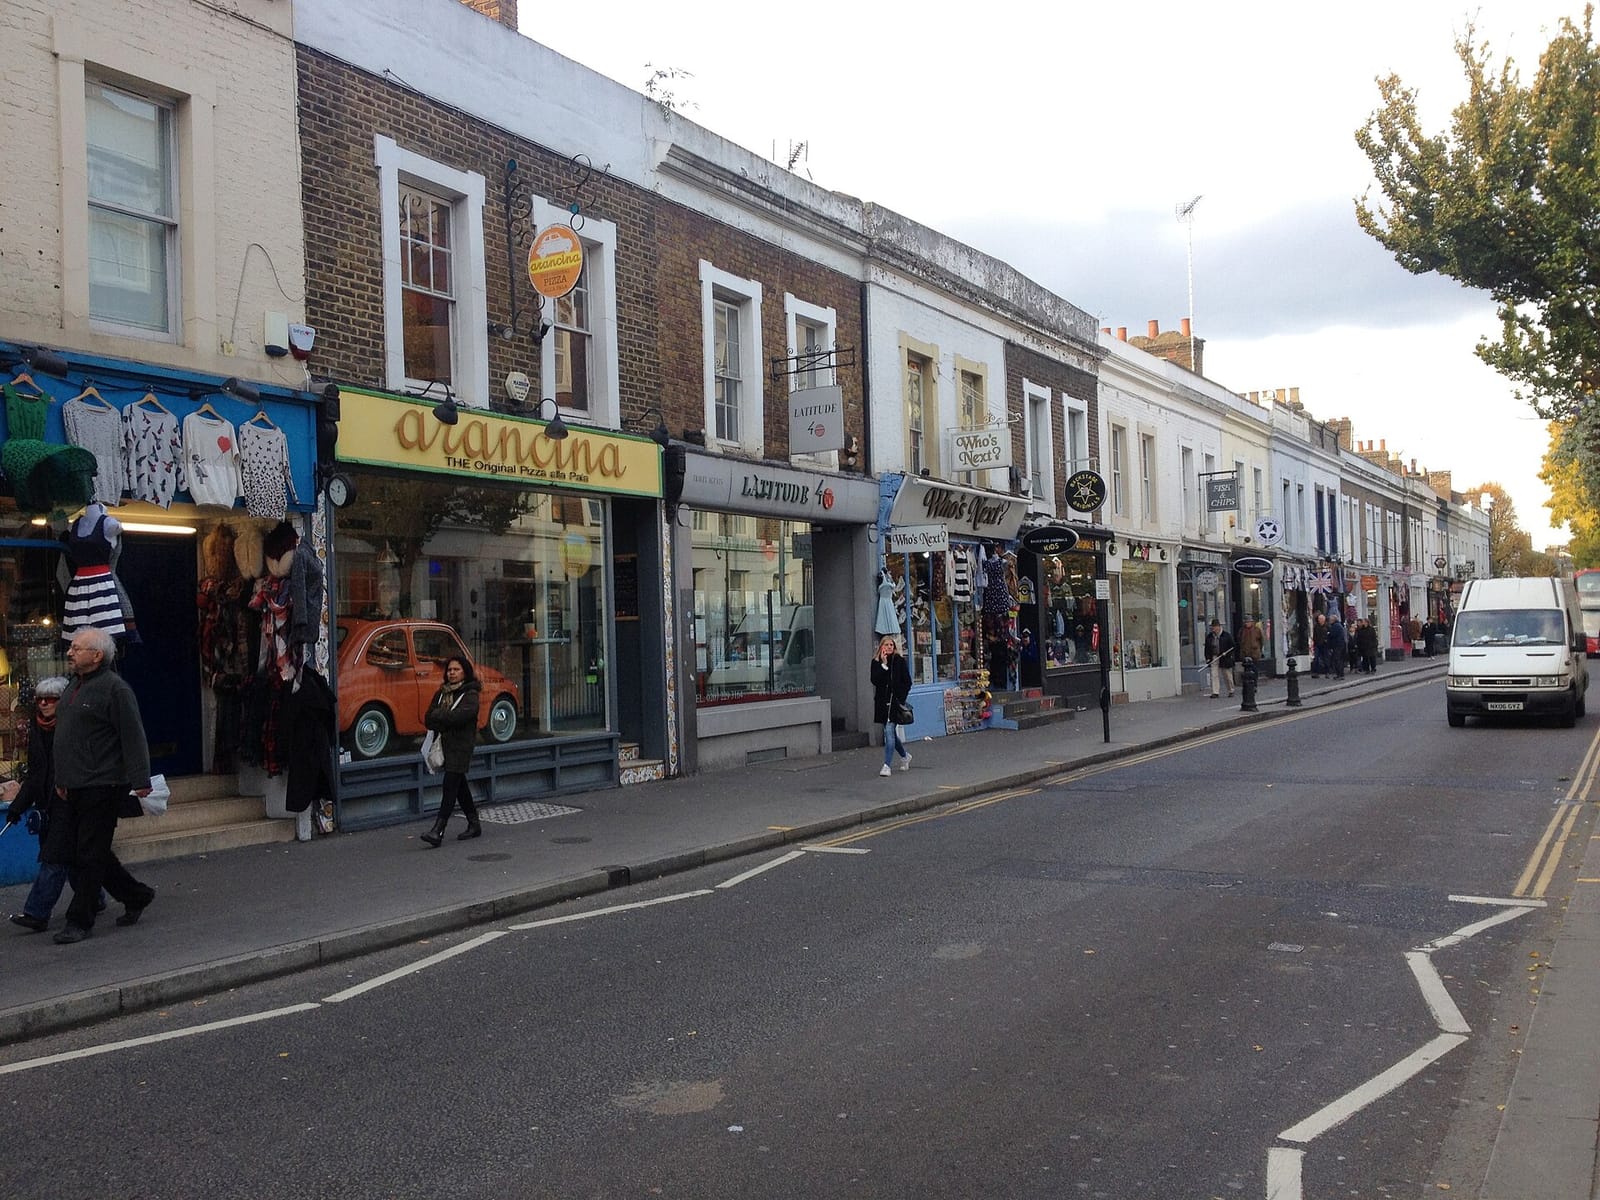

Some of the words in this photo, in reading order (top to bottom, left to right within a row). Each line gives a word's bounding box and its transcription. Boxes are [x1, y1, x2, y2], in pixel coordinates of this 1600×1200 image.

[530, 254, 581, 271] arancina
[543, 275, 567, 287] PIZZA
[794, 403, 838, 418] LATITUDE
[394, 408, 627, 478] arancina
[956, 433, 998, 450] Who's
[959, 446, 1001, 467] Next?
[444, 456, 471, 469] THE
[474, 460, 516, 474] Original
[520, 466, 547, 477] Pizza
[741, 474, 809, 505] LATITUDE
[1213, 484, 1232, 493] FISH
[923, 487, 967, 520] Who's
[966, 495, 1011, 531] Next?
[1211, 498, 1236, 507] CHIPS
[892, 533, 918, 547] Who's
[919, 530, 947, 547] Next?
[1043, 542, 1060, 552] KIDS
